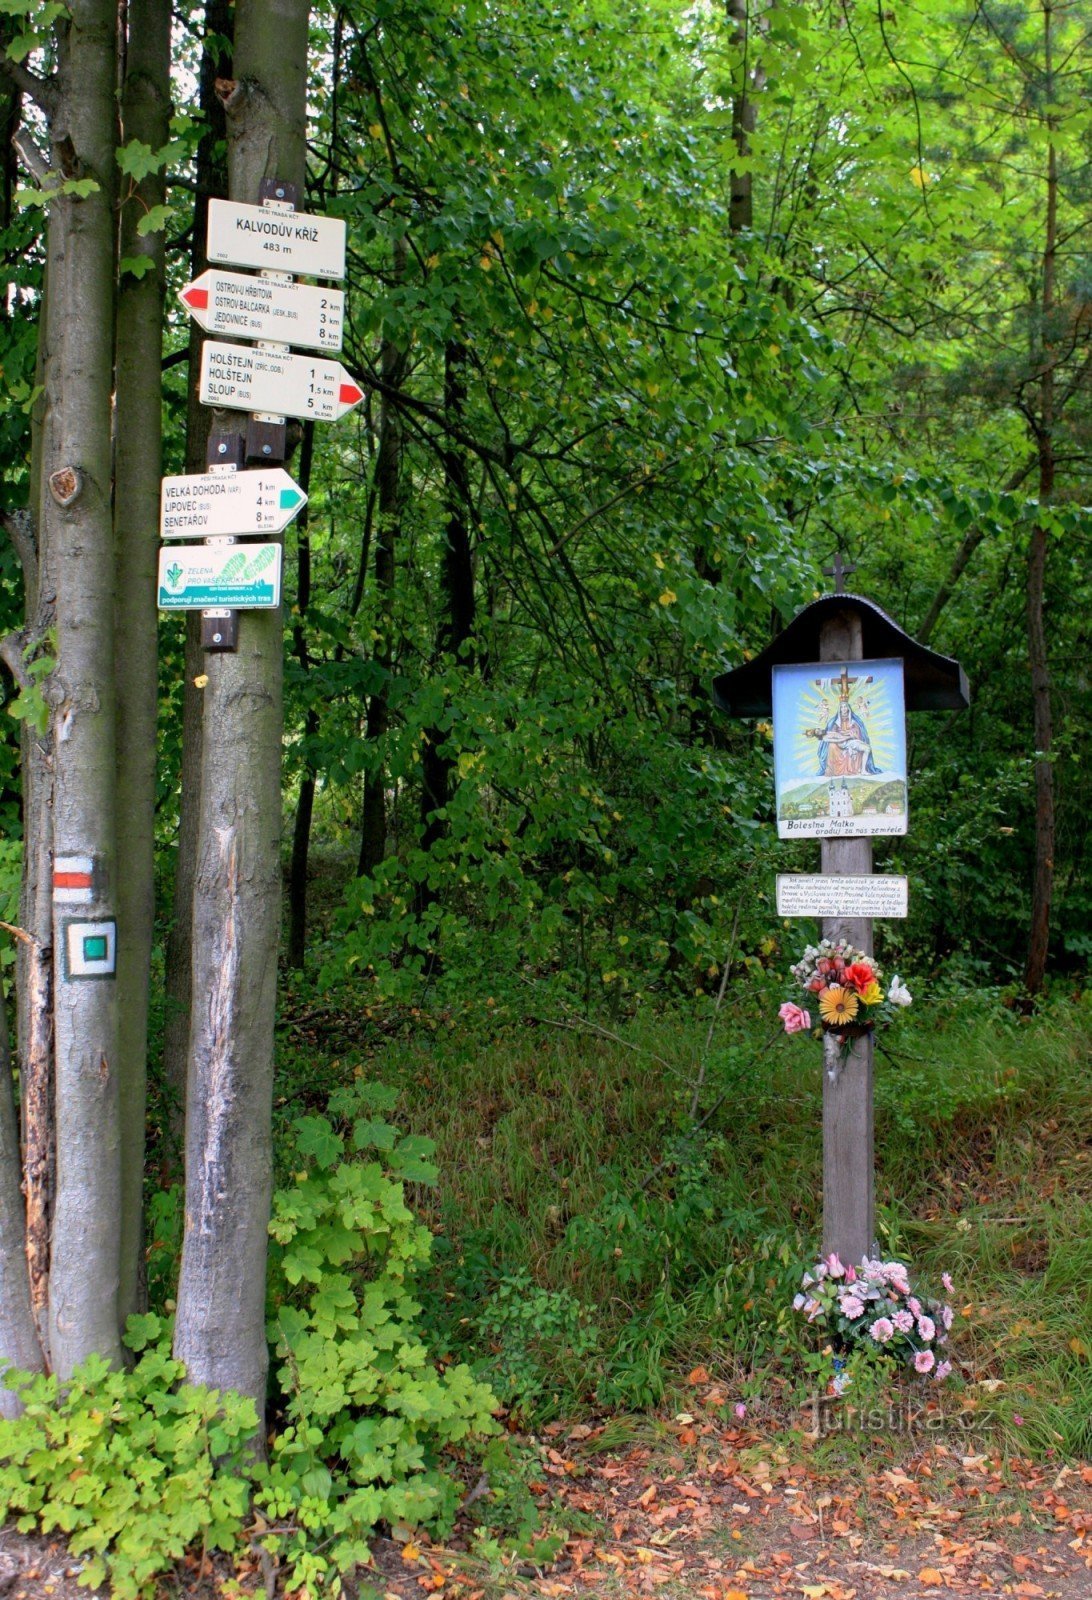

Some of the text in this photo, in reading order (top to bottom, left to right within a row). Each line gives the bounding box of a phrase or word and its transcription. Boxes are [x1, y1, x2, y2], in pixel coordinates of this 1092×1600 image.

[236, 218, 319, 242] KALVODŮV KŘÍŽ
[263, 242, 280, 252] 483
[321, 299, 340, 311] 2 km
[215, 312, 248, 326] JEDOVNICE
[320, 314, 326, 323] 3
[319, 329, 325, 338] 8
[210, 353, 253, 368] HOLŠTEJN
[209, 368, 252, 383] HOLŠTEJN
[310, 369, 314, 378] 1
[208, 383, 251, 400] SLOUP (BUS)
[309, 384, 334, 396] 1,5 km
[308, 398, 314, 408] 5
[166, 484, 191, 498] VELKÁ
[193, 484, 226, 496] DOHODA
[258, 482, 262, 491] 1
[165, 501, 196, 512] LIPOVEC
[257, 497, 262, 506] 4
[164, 514, 208, 527] SENETÁŘOV
[256, 512, 262, 522] 8
